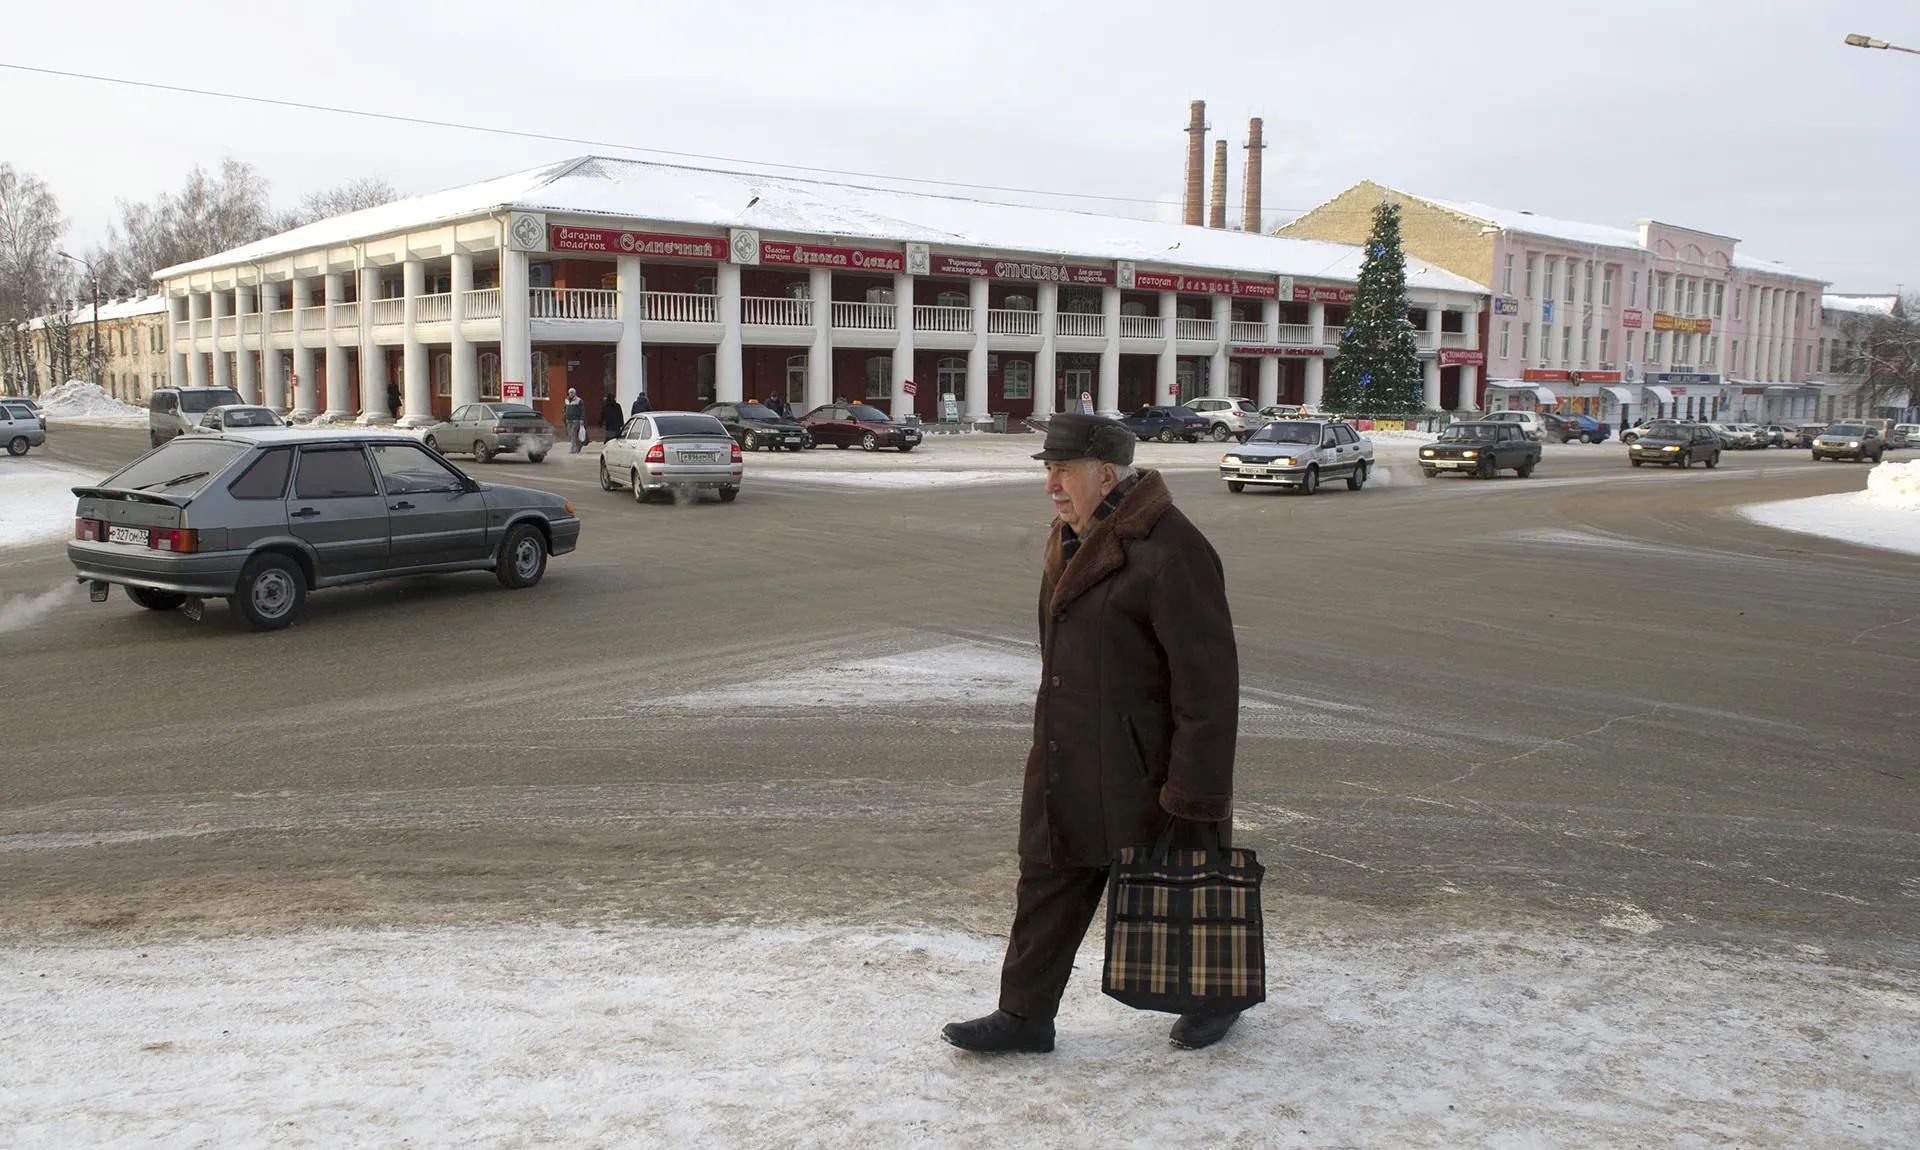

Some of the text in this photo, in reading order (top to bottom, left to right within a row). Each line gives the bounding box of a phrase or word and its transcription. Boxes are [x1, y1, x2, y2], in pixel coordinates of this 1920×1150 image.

[560, 228, 602, 241] Магазин
[560, 241, 606, 250] подарков
[793, 246, 900, 269] Мужская Одежда
[1138, 276, 1172, 287] ресторан
